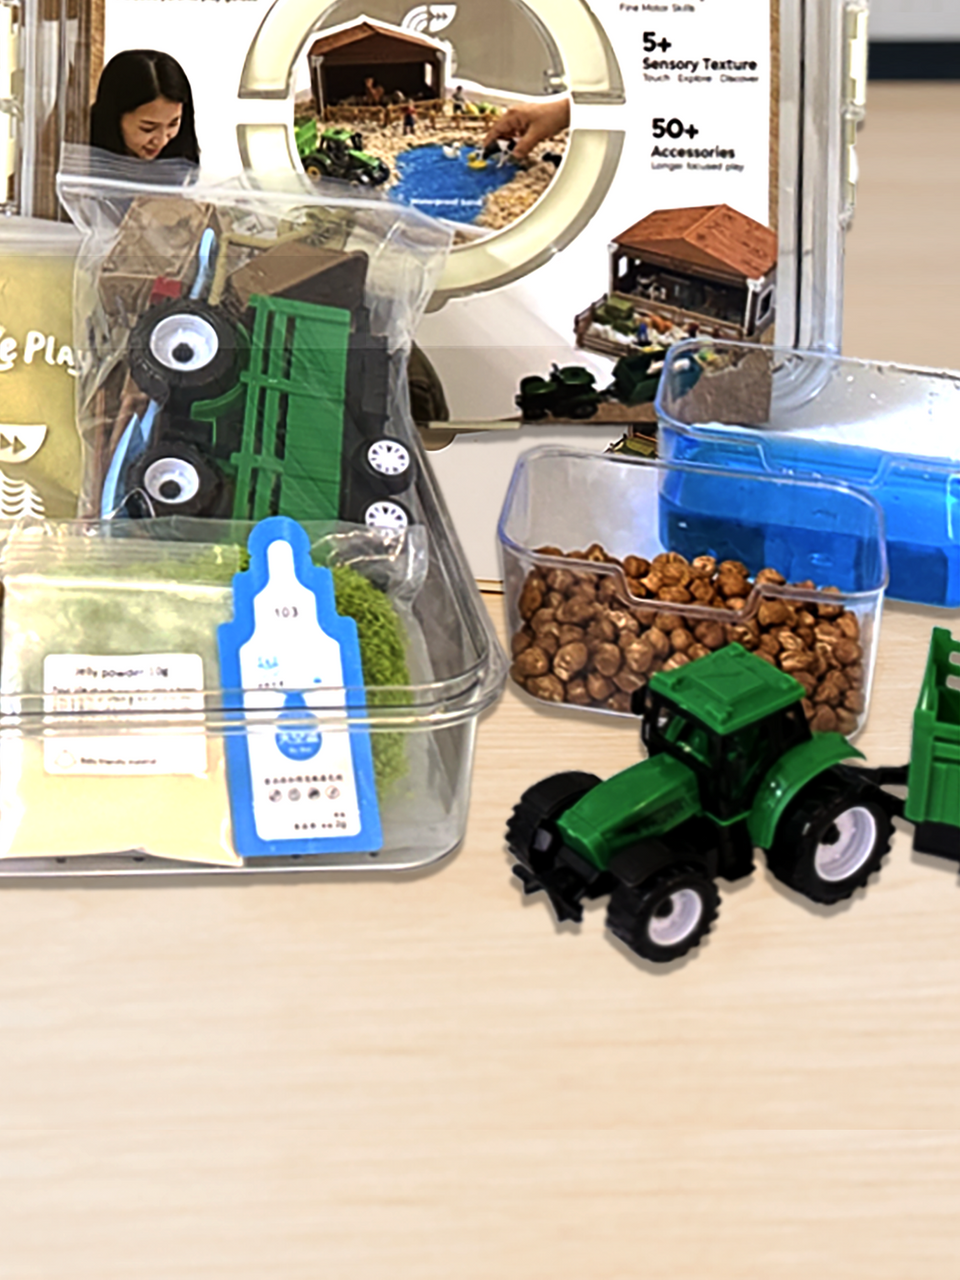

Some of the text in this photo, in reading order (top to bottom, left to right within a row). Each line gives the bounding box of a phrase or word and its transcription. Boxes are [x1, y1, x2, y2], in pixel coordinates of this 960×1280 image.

[619, 3, 639, 12] Fine
[643, 31, 672, 53] 5+
[643, 57, 757, 73] Sensory Texture
[652, 117, 699, 139] 50+
[651, 145, 735, 159] Accessories
[275, 605, 299, 618] 103
